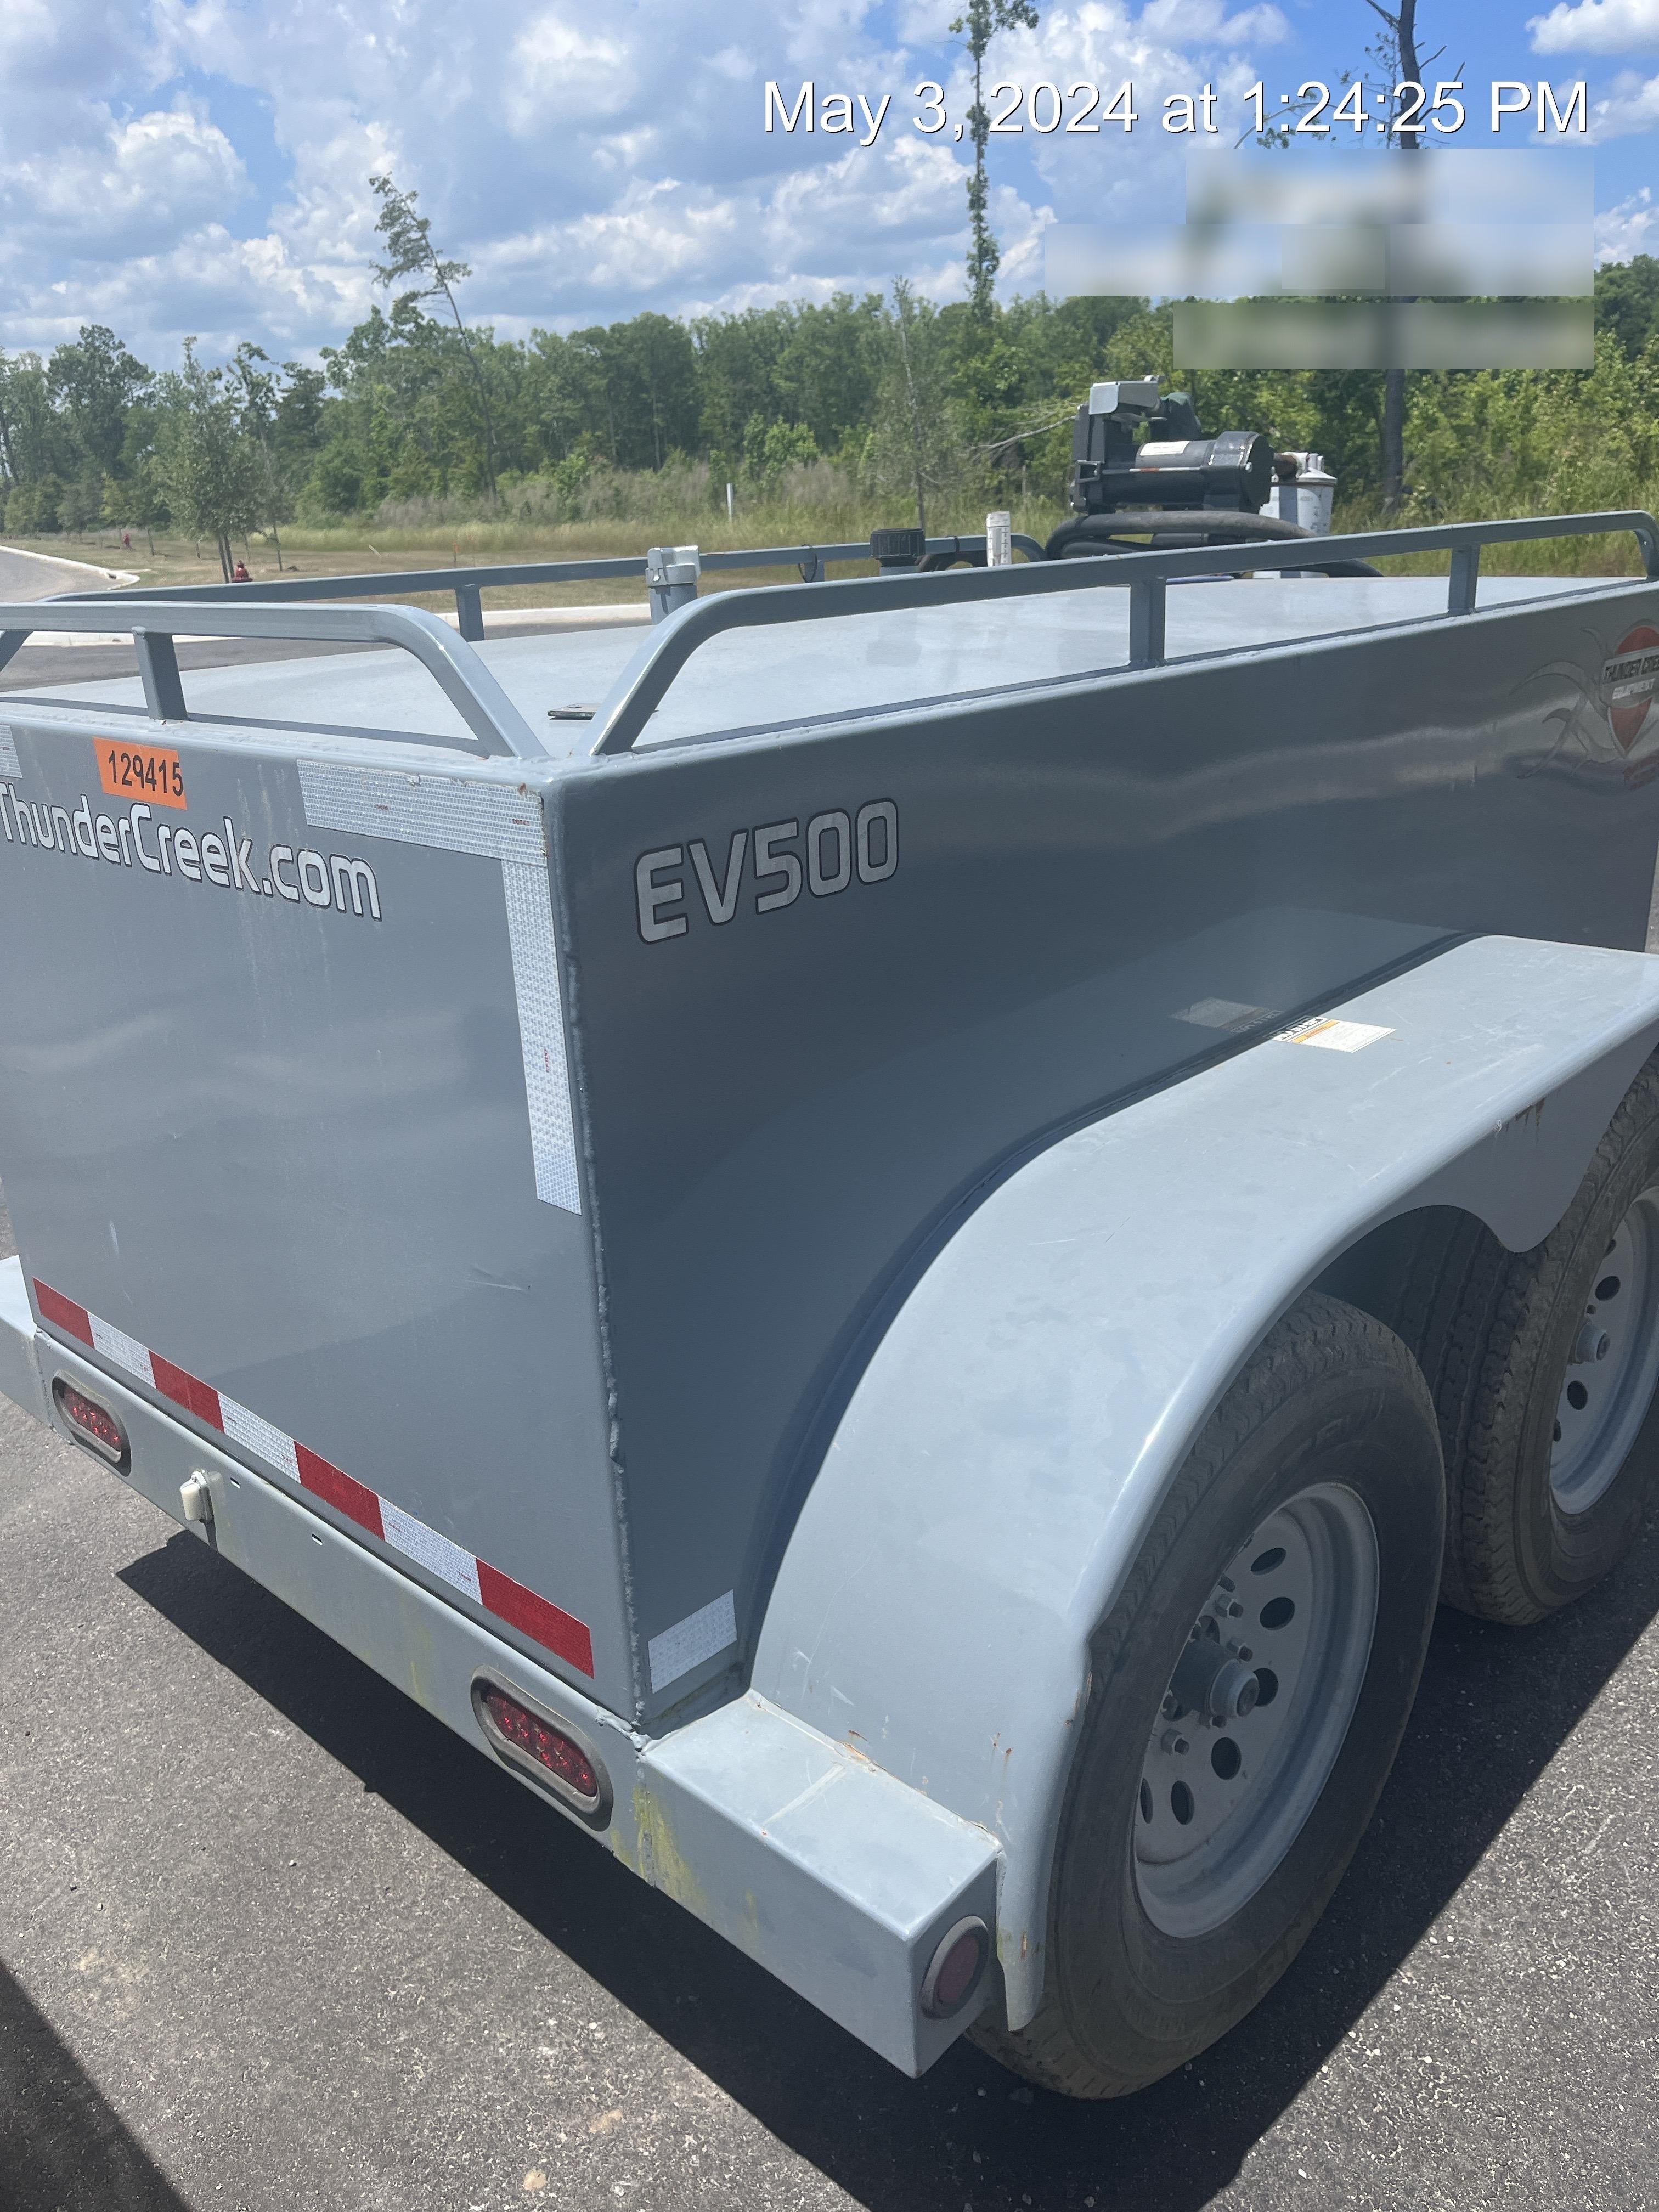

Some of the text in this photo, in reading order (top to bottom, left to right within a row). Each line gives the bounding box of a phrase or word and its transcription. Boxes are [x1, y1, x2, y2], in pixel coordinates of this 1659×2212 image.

[108, 750, 183, 797] 129415
[0, 781, 382, 921] ThunderCreek.com
[635, 798, 899, 944] EV500
